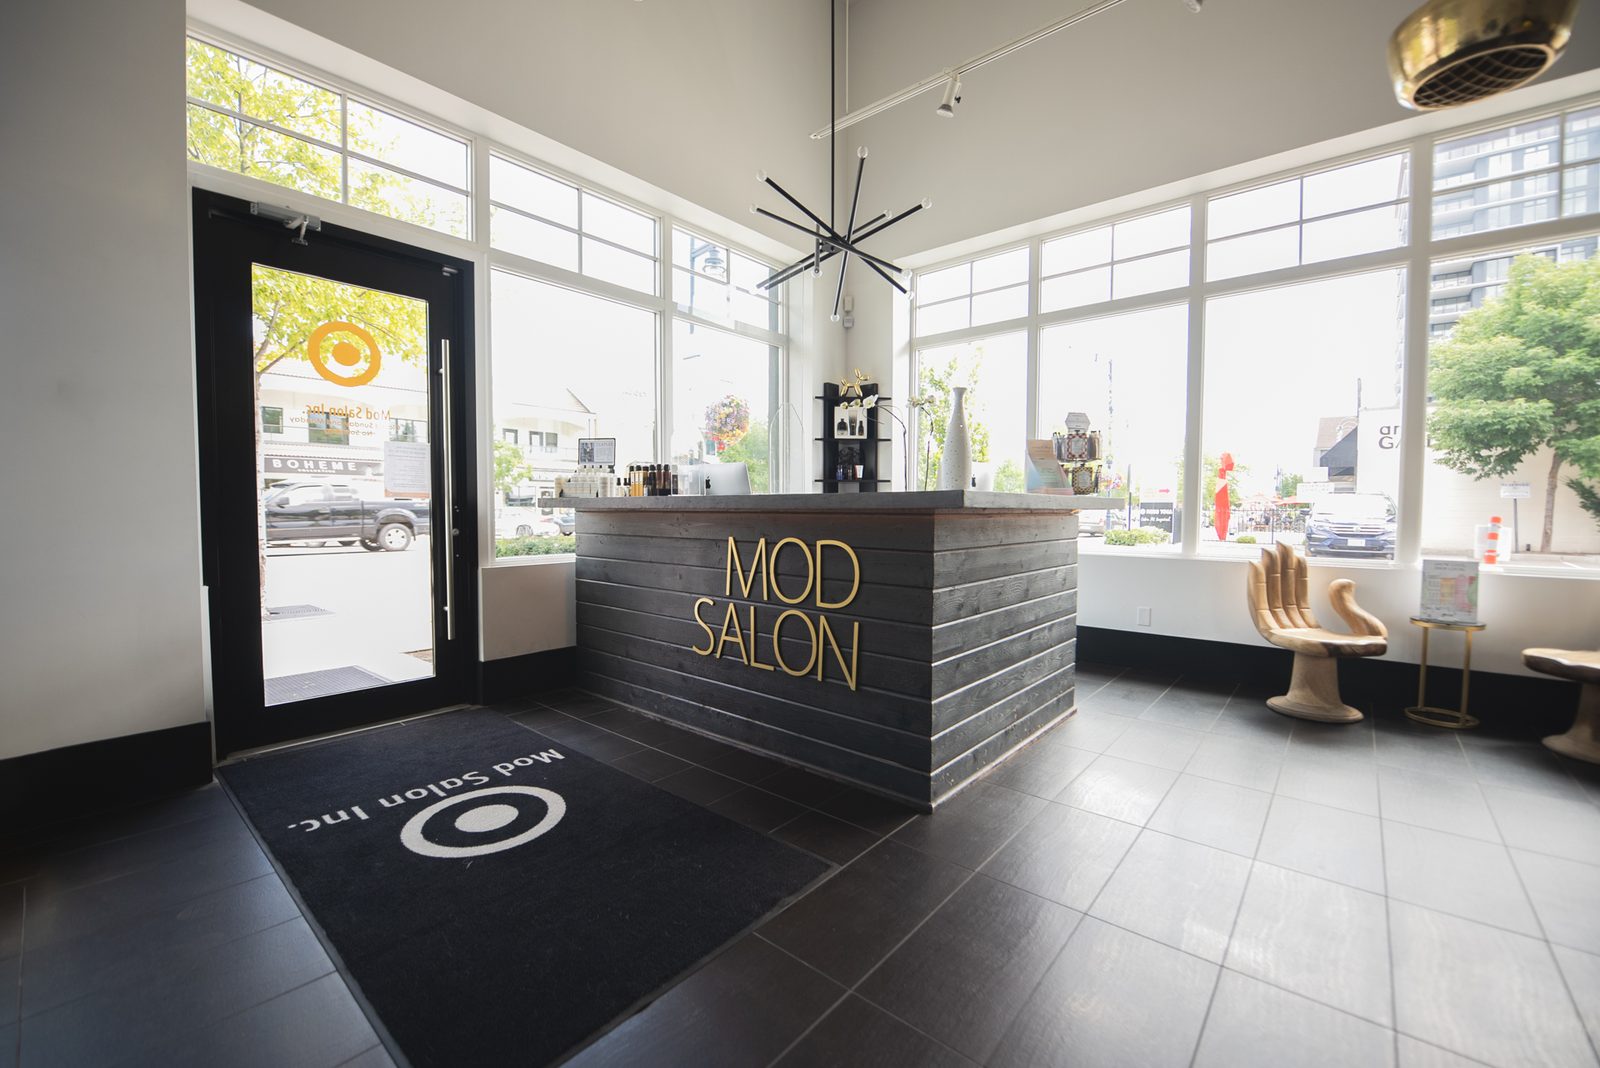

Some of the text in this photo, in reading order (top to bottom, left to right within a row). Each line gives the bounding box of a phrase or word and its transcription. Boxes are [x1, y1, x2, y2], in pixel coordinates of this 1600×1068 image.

[272, 458, 357, 472] BOHEME
[726, 536, 860, 609] MOD
[692, 597, 860, 691] SALON
[287, 748, 566, 833] Mod Salon Inc.
